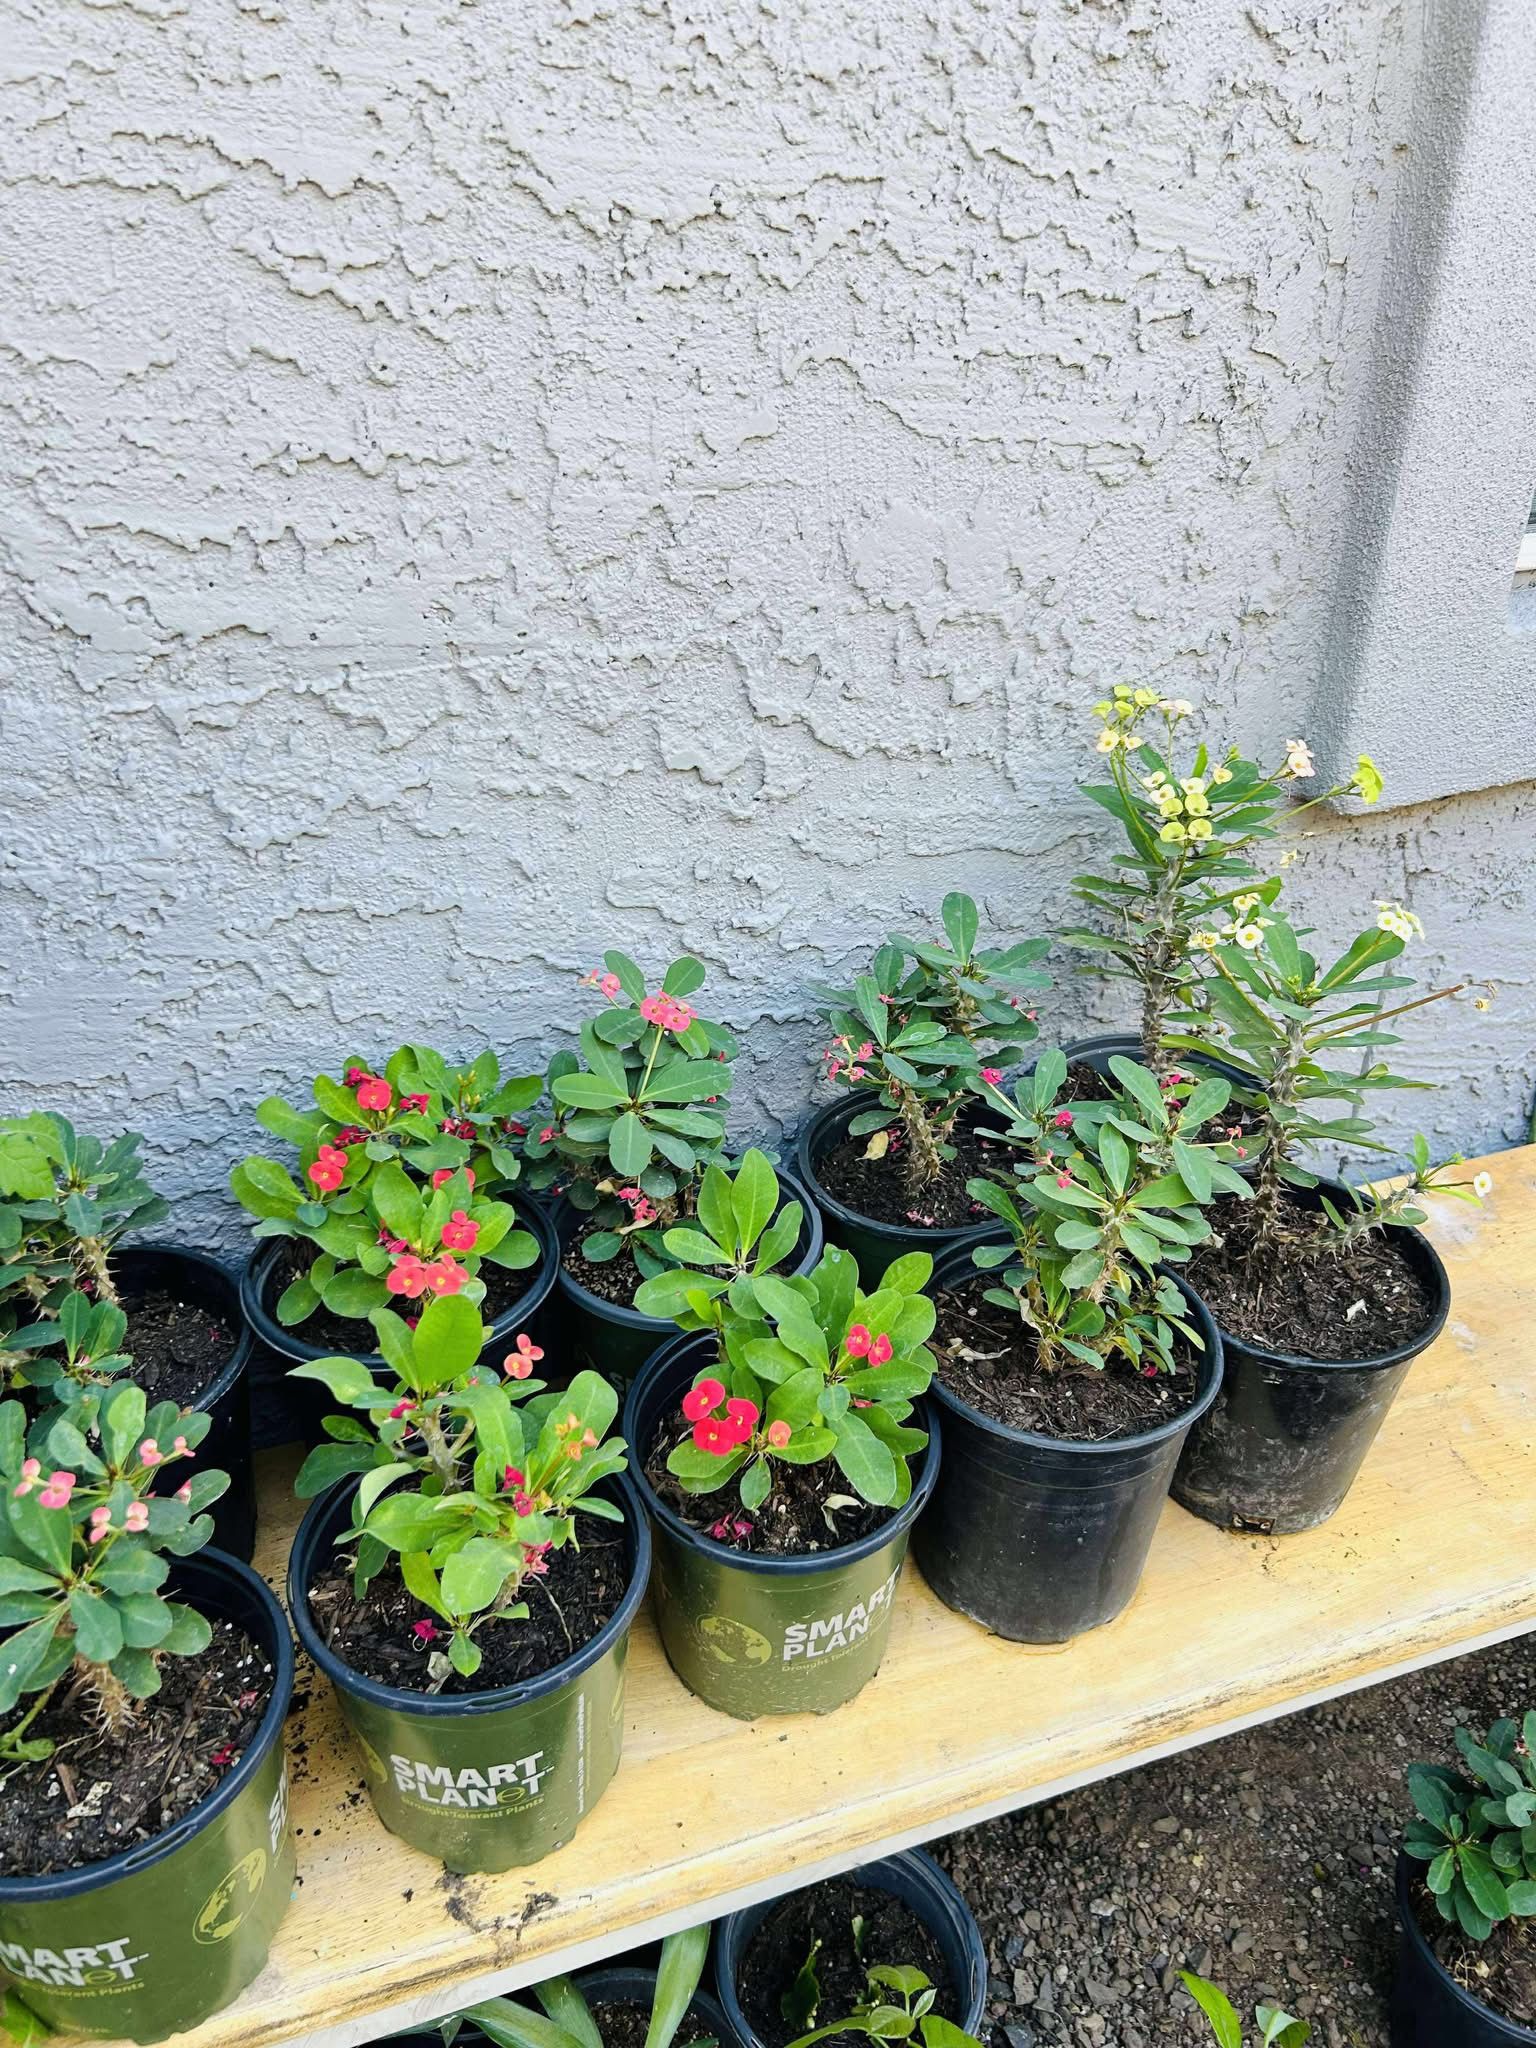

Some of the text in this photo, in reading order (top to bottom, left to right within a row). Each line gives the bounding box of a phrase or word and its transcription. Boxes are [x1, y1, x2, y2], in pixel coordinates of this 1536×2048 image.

[784, 1564, 900, 1644] SMART
[782, 1659, 830, 1672] Drought
[390, 1751, 544, 1788] SMART
[450, 1809, 503, 1820] Tolerant
[505, 1797, 545, 1816] Plants
[0, 1937, 131, 1969] MART
[99, 1981, 145, 1996] Plants
